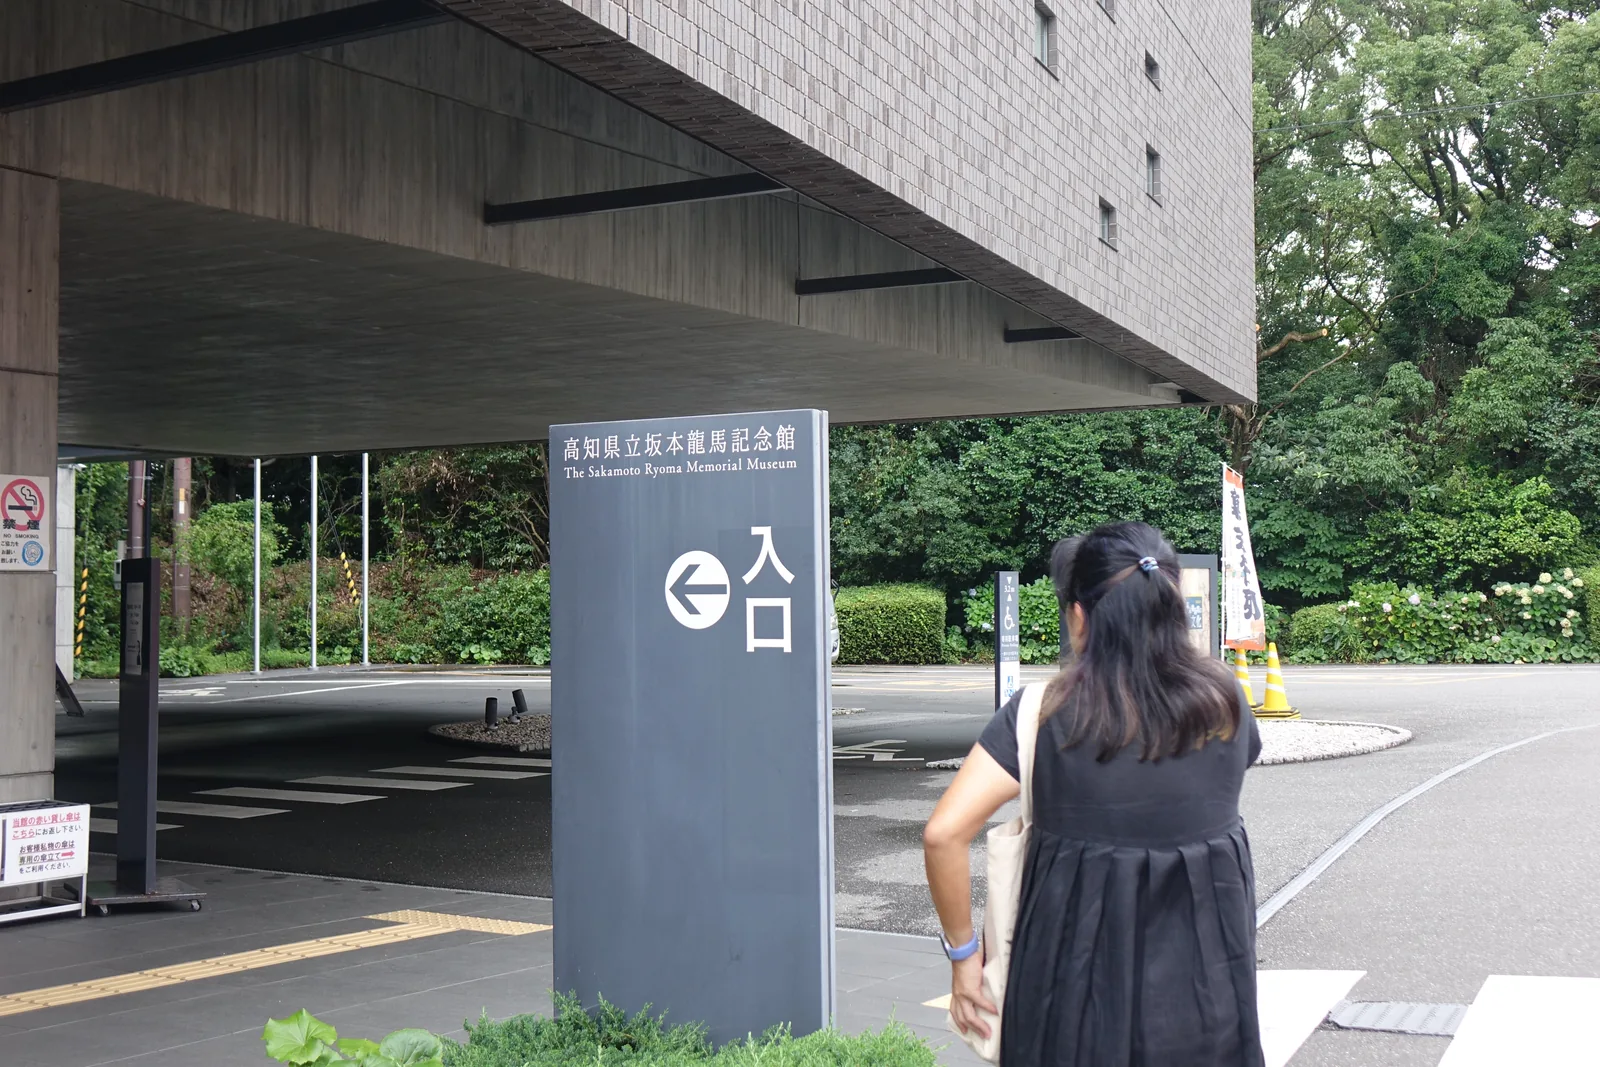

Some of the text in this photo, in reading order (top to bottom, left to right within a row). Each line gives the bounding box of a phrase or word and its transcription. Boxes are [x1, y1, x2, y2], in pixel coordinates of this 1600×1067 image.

[563, 424, 796, 461] 高知県立坂本龍馬記念館
[564, 457, 798, 479] The Sakamoto Ryoma Memorial Museum
[3, 518, 40, 530] 禁煙
[741, 525, 796, 653] 入口
[20, 840, 75, 854] お客様私物の傘は
